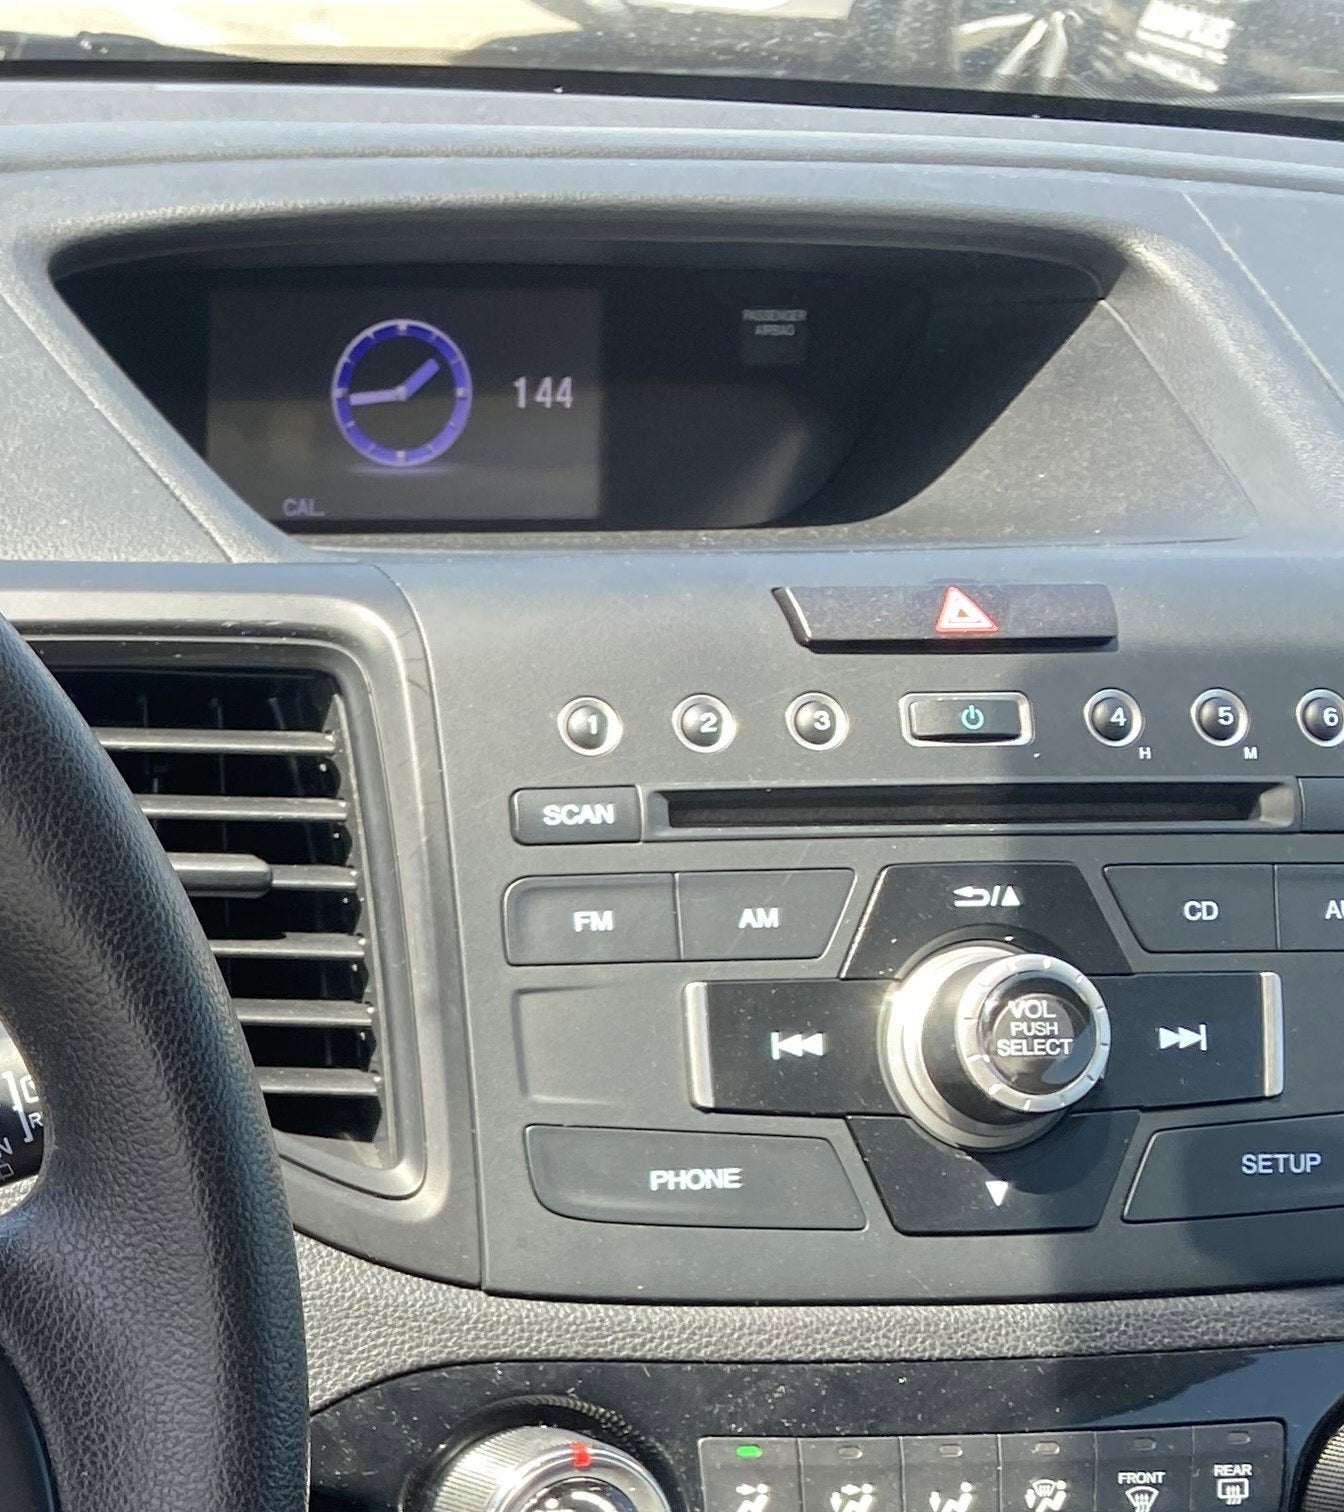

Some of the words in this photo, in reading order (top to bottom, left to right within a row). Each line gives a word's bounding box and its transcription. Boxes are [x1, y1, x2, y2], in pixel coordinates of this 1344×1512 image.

[587, 714, 598, 735] 1
[700, 712, 718, 733] 2
[814, 710, 831, 731] 3
[1110, 707, 1127, 727] 4
[1218, 706, 1234, 725] 5
[1323, 707, 1339, 727] 6
[1139, 747, 1152, 760] H
[1244, 746, 1258, 760] M
[543, 803, 615, 826] SCAN
[738, 907, 780, 929] AM
[1183, 900, 1219, 921] CD
[573, 910, 614, 932] FM
[1007, 999, 1057, 1019] VOL
[1010, 1021, 1059, 1036] PUSH
[996, 1038, 1074, 1057] SELECT
[1241, 1152, 1322, 1175] SETUP
[649, 1168, 743, 1191] PHONE
[1117, 1471, 1166, 1485] FRONT
[1213, 1463, 1253, 1477] REAR
